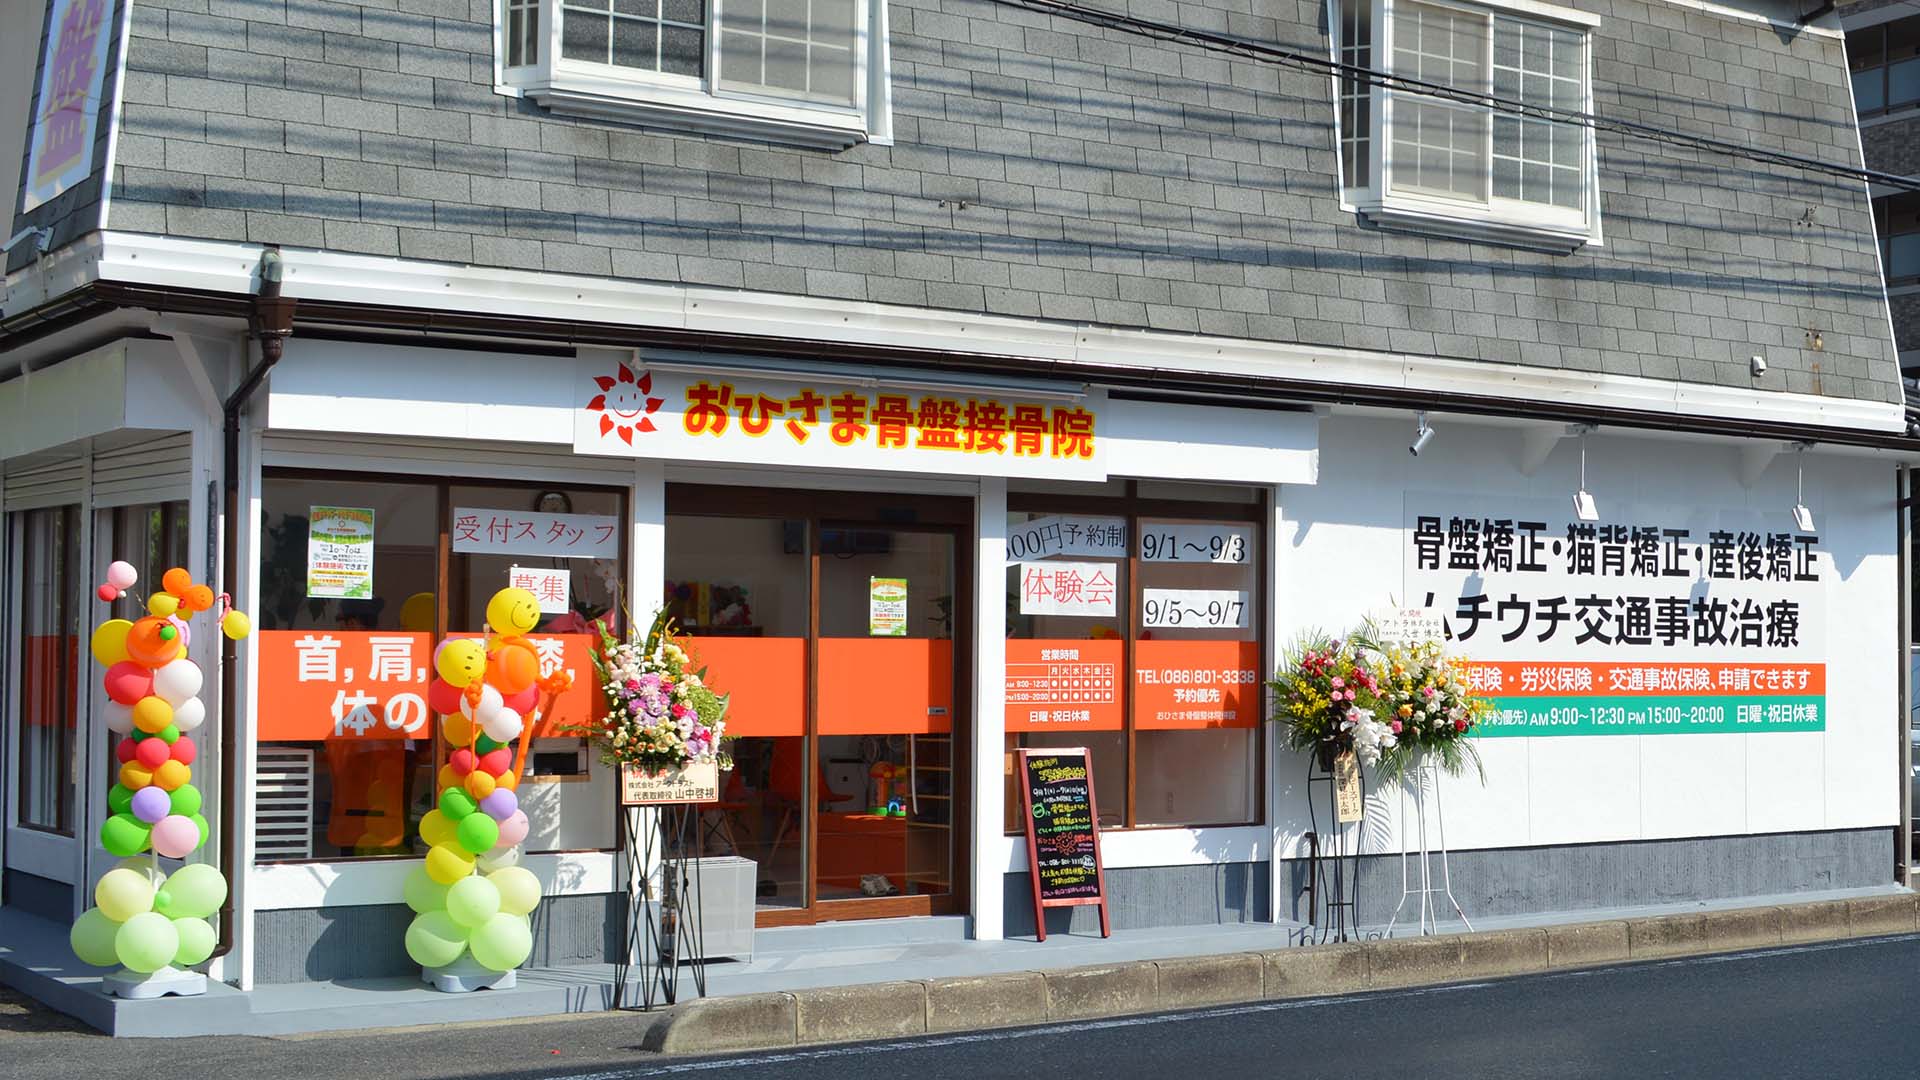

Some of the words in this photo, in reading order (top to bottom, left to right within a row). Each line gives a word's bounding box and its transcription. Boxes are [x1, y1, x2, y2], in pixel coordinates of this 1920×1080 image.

[684, 381, 1095, 459] おひさま骨盤接骨院
[455, 515, 615, 546] 受付スタッフ
[1413, 516, 1819, 582] 骨盤矯正・猫背矯正・産後矯正
[1023, 568, 1114, 605] 体験会
[1041, 649, 1079, 661] 営業時間
[1136, 669, 1255, 684] TEL(086)801-3338
[1173, 688, 1221, 703] 予約優先
[1530, 714, 1549, 726] AM
[1551, 707, 1625, 725] 9:00~12:30
[1628, 712, 1646, 725] PM
[1647, 706, 1725, 724] 15:00~20:00
[1736, 704, 1818, 724] 日曜・祝日休業
